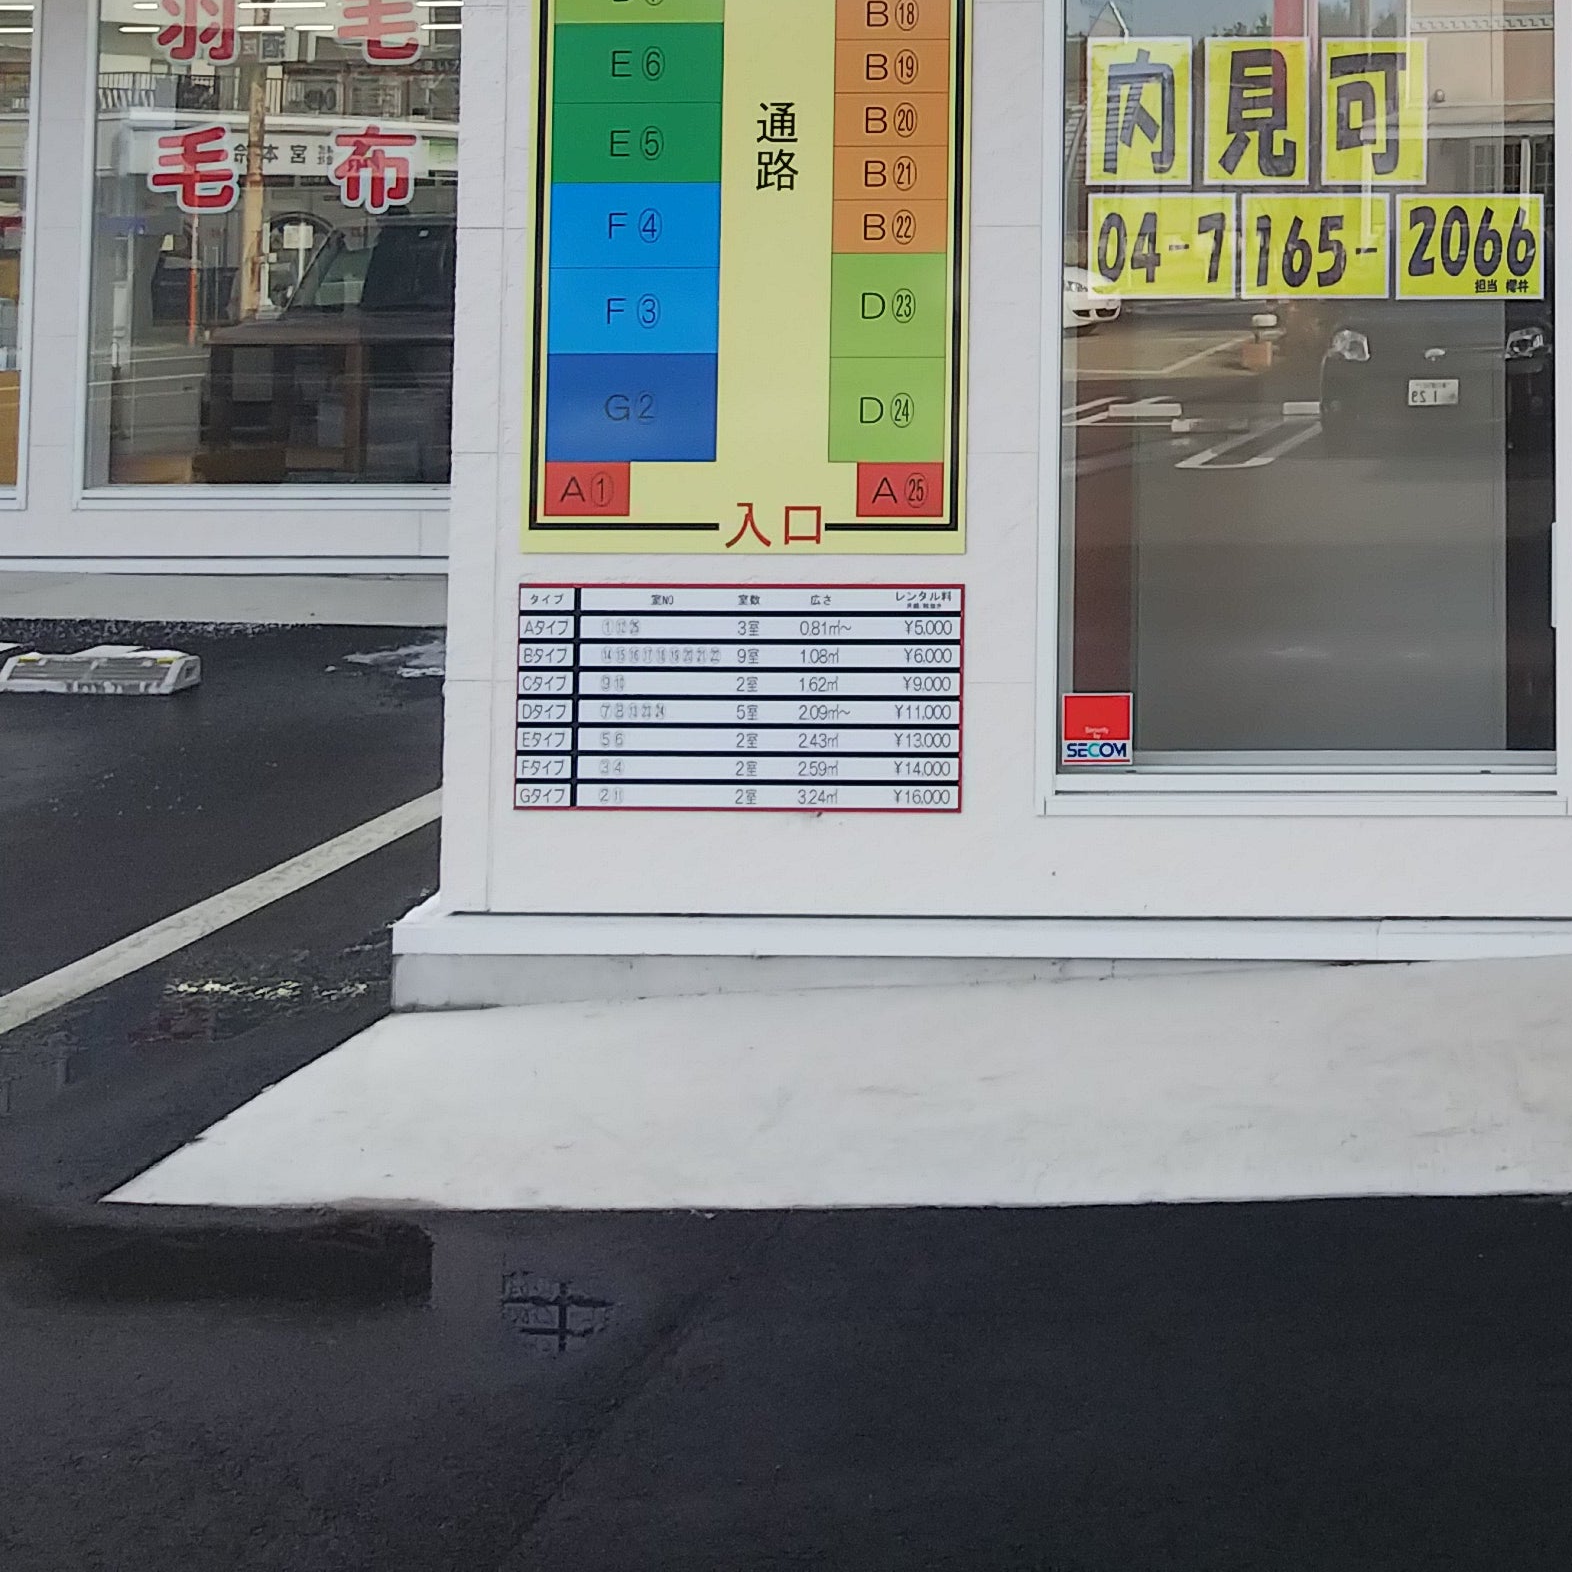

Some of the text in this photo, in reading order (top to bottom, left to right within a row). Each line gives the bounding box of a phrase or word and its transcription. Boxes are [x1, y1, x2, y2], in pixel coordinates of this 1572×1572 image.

[1102, 48, 1407, 177] 内見可
[756, 101, 799, 191] 通路
[149, 123, 420, 212] 毛布
[725, 502, 822, 548] 入口
[530, 593, 564, 606] タイプ
[811, 594, 832, 606] 広さ
[896, 591, 952, 602] レンタル料
[523, 620, 569, 635] Aタイプ
[737, 620, 760, 636] 3室
[523, 648, 567, 663] Bタイプ
[737, 648, 759, 664] 9室
[522, 676, 566, 691] Cタイプ
[736, 676, 758, 692] 2室
[522, 704, 566, 719] Dタイプ
[736, 704, 758, 720] 5室
[522, 732, 565, 747] Eタイプ
[736, 732, 758, 748] 2室
[1067, 742, 1127, 758] SECOM
[521, 760, 564, 775] Fタイプ
[735, 760, 758, 776] 2室
[520, 789, 565, 804] Gタイプ
[735, 789, 757, 805] 2室
